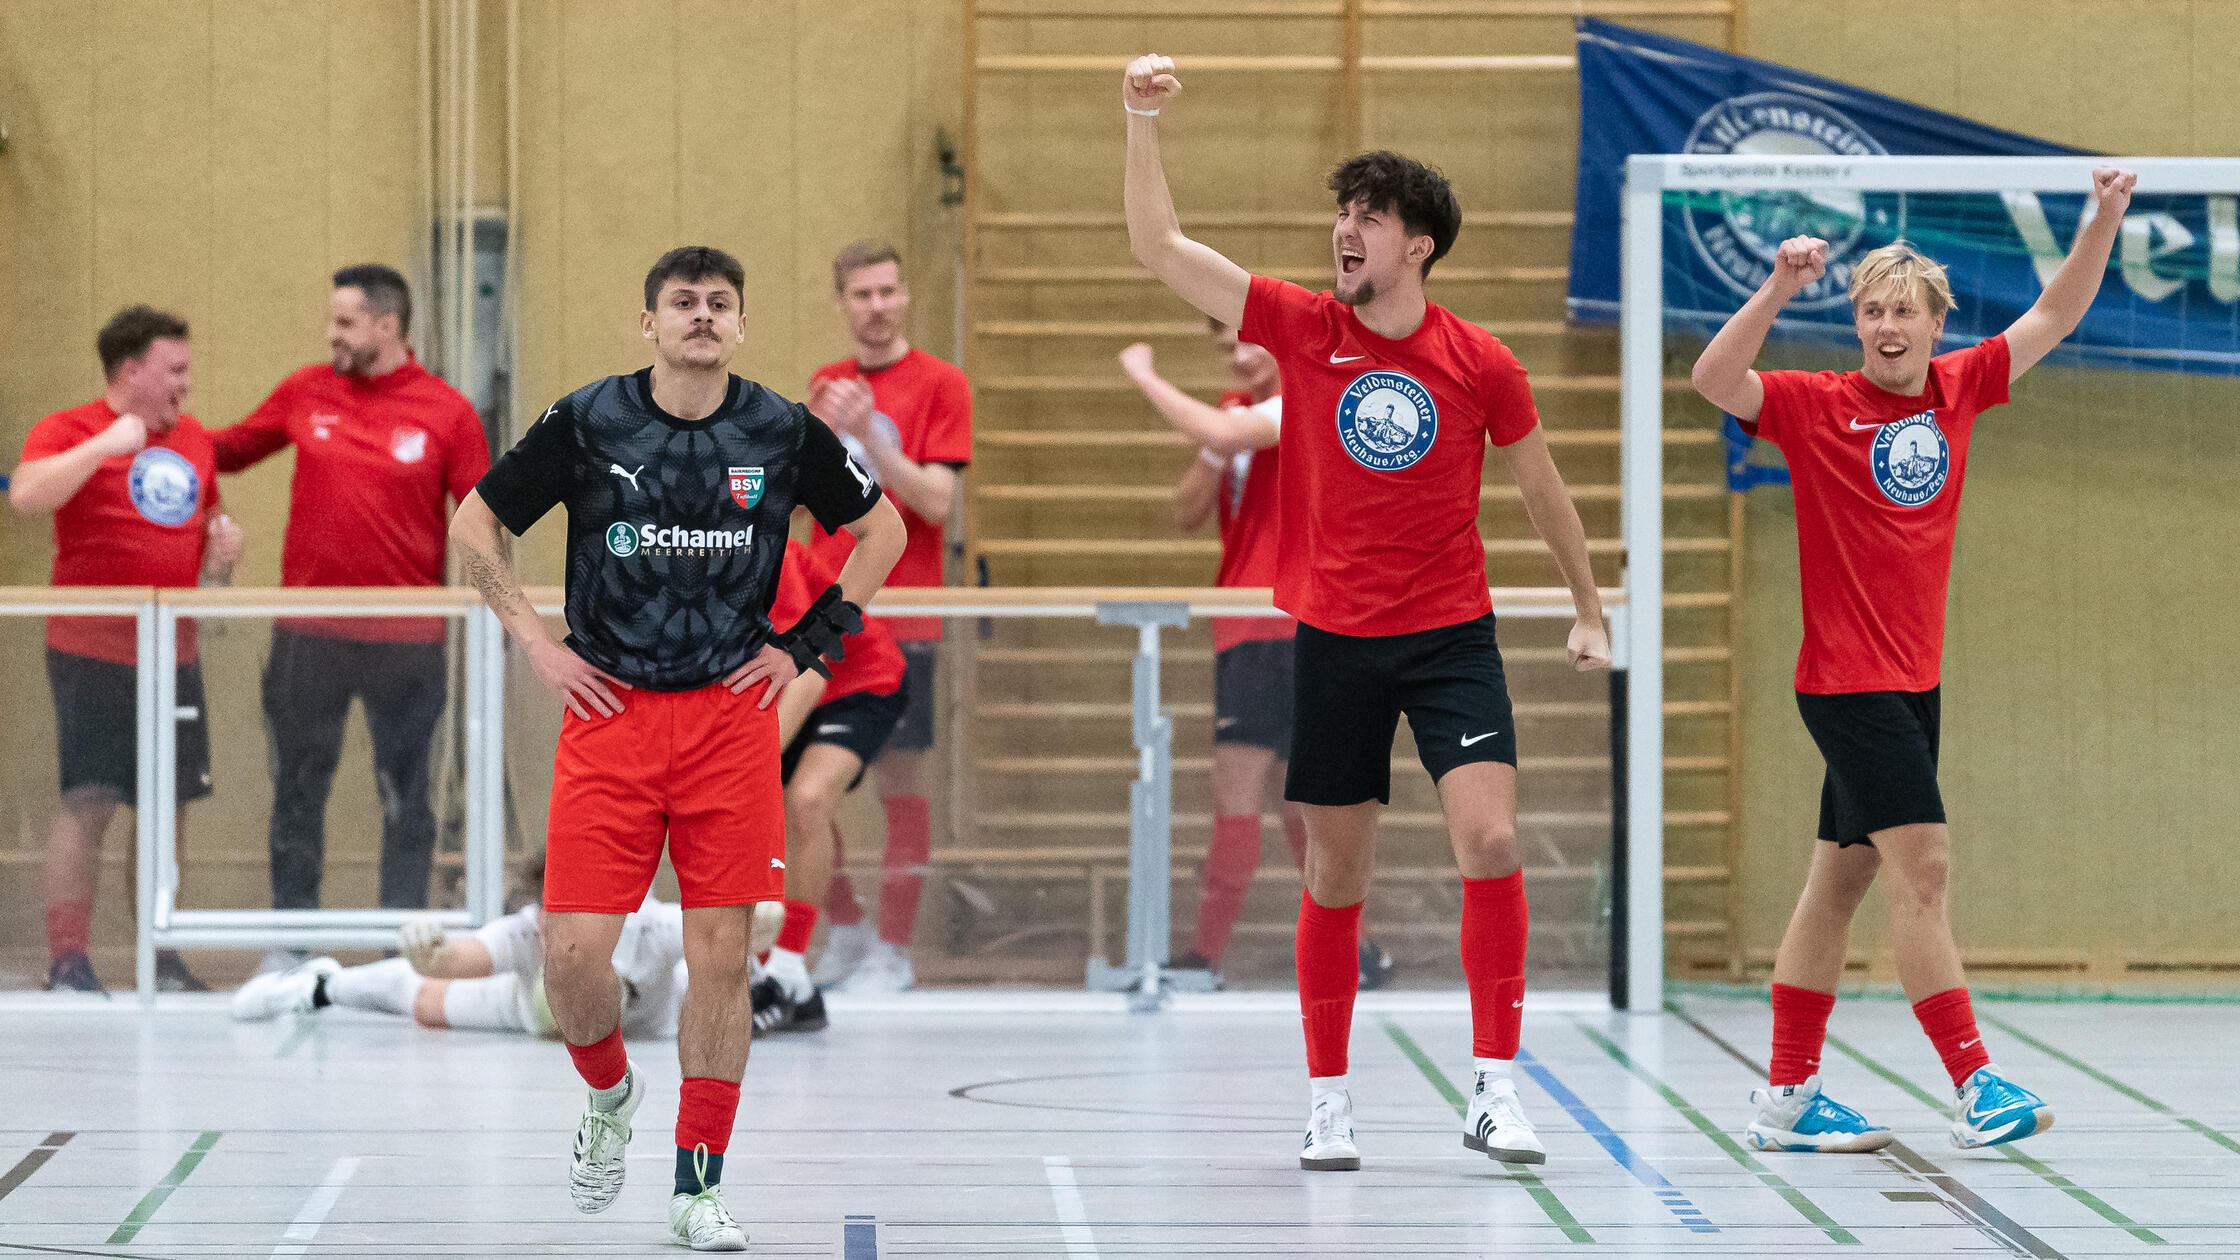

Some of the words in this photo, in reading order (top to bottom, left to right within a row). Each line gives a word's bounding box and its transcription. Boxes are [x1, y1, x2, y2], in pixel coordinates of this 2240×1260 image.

[1349, 376, 1431, 422] Veldensteiner
[1344, 428, 1421, 466] Neuhaus/Peg.
[731, 478, 762, 491] BSV
[640, 523, 753, 548] Schamel
[640, 547, 751, 556] MEERRETTICH
